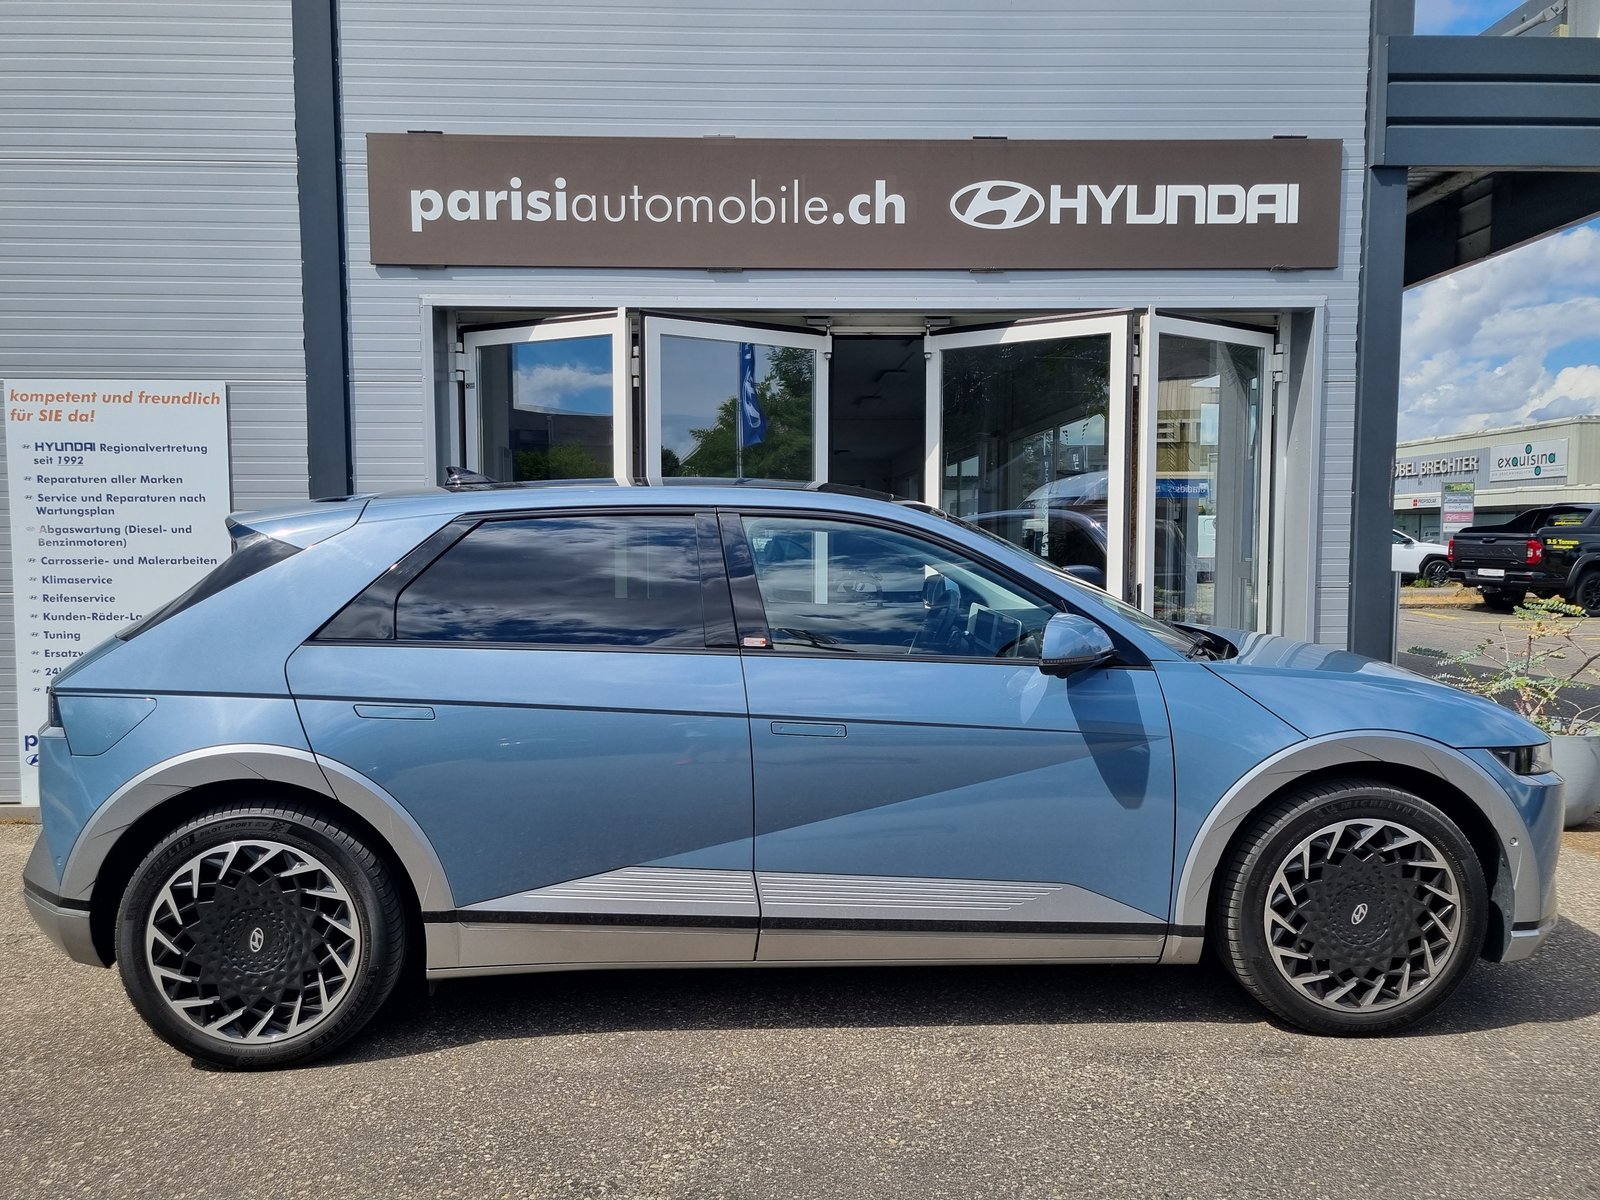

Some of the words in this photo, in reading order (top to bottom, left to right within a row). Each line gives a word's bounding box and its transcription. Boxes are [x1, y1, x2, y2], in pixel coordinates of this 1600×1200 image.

[410, 177, 906, 232] parisiautomobile.ch
[1050, 184, 1300, 225] HYUNDAI
[10, 389, 97, 405] kompetent
[102, 391, 134, 404] und
[138, 391, 221, 405] freundlich
[10, 409, 33, 422] für
[38, 410, 63, 422] SIE
[68, 410, 96, 422] da!
[35, 442, 96, 452] HYUNDAI
[100, 443, 209, 454] Regionalvertretung
[34, 456, 53, 465] seit
[57, 456, 84, 466] 1992
[1420, 456, 1478, 475] BRECHTER
[1498, 449, 1557, 471] exquisina
[37, 475, 107, 486] Reparaturen
[111, 475, 136, 484] aller
[140, 475, 184, 484] Marken
[38, 494, 78, 503] Service
[81, 494, 103, 503] und
[106, 494, 176, 505] Reparaturen
[180, 494, 206, 503] nach
[36, 507, 115, 517] Wartungsplan
[39, 525, 121, 536] Abgaswartung
[125, 525, 168, 536] (Diesel-
[171, 525, 193, 534] und
[38, 538, 127, 549] Benzinmotoren)
[41, 557, 109, 566] Carrosserie-
[113, 557, 134, 566] und
[138, 557, 218, 566] Malerarbeiten
[42, 576, 113, 585] Klimaservice
[43, 594, 116, 603] Reifenservice
[43, 612, 143, 621] Kunden-Räder-La
[44, 631, 81, 642] Tuning
[225, 821, 253, 831] SPORT
